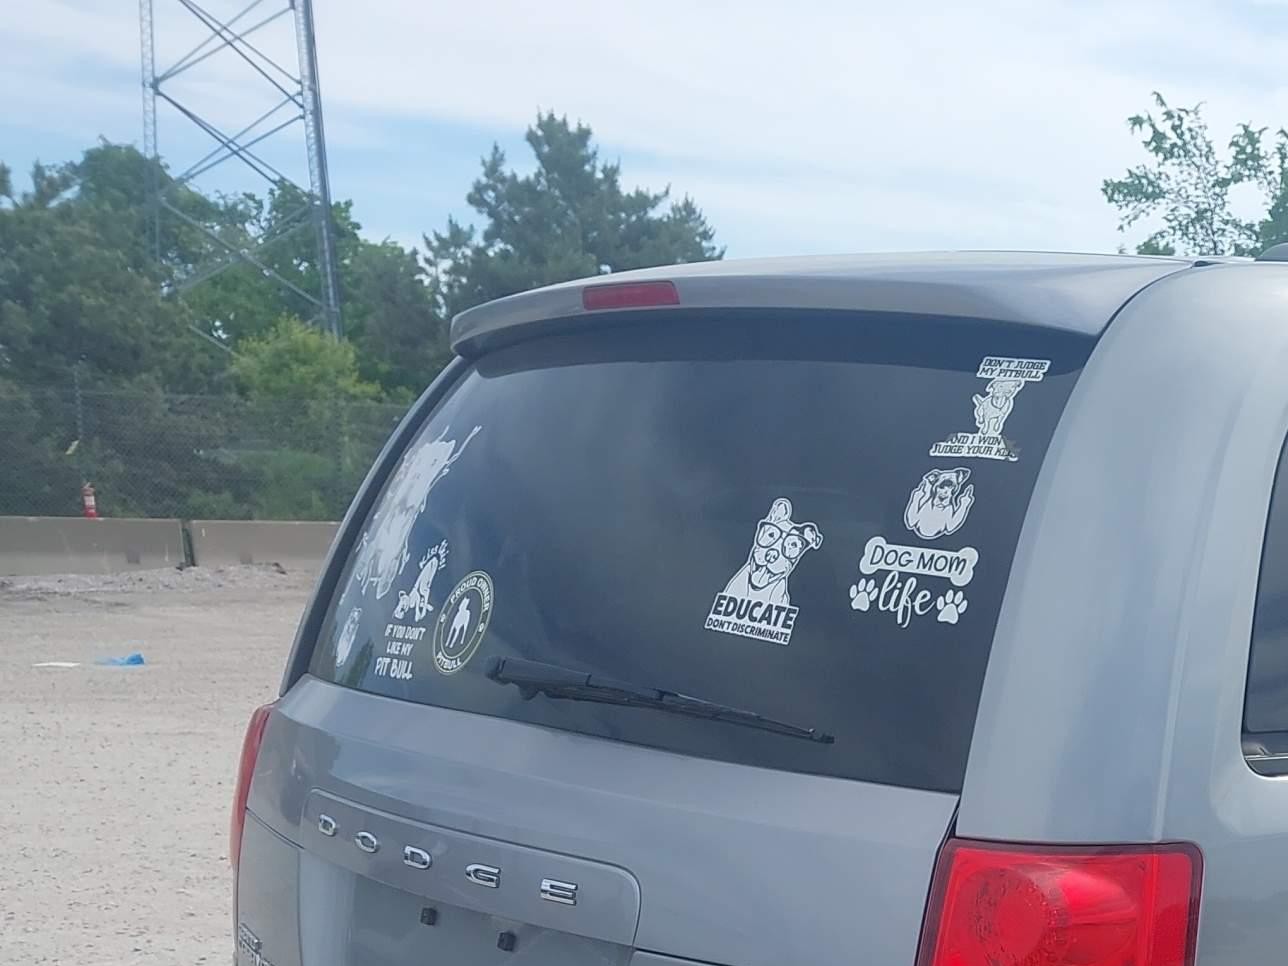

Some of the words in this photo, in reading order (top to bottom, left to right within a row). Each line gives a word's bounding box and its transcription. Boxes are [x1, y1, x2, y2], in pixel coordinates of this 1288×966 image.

[980, 367, 996, 376] MY
[999, 368, 1042, 379] PITBULL
[983, 358, 1011, 368] DON'T
[1014, 360, 1047, 371] JUDGE
[932, 443, 963, 454] JUDGE
[966, 445, 993, 455] YOUR
[870, 546, 913, 568] DOG
[450, 577, 478, 604] PROUD
[477, 577, 490, 612] OWNER
[878, 571, 935, 628] life
[712, 595, 797, 629] EDUCATE
[392, 625, 406, 639] YOU
[731, 622, 790, 643] DISCRIMINATE
[386, 641, 402, 655] LIKE
[401, 643, 414, 656] MY
[374, 657, 391, 676] PIT
[390, 658, 413, 680] BULL
[318, 813, 578, 906] DODGE
